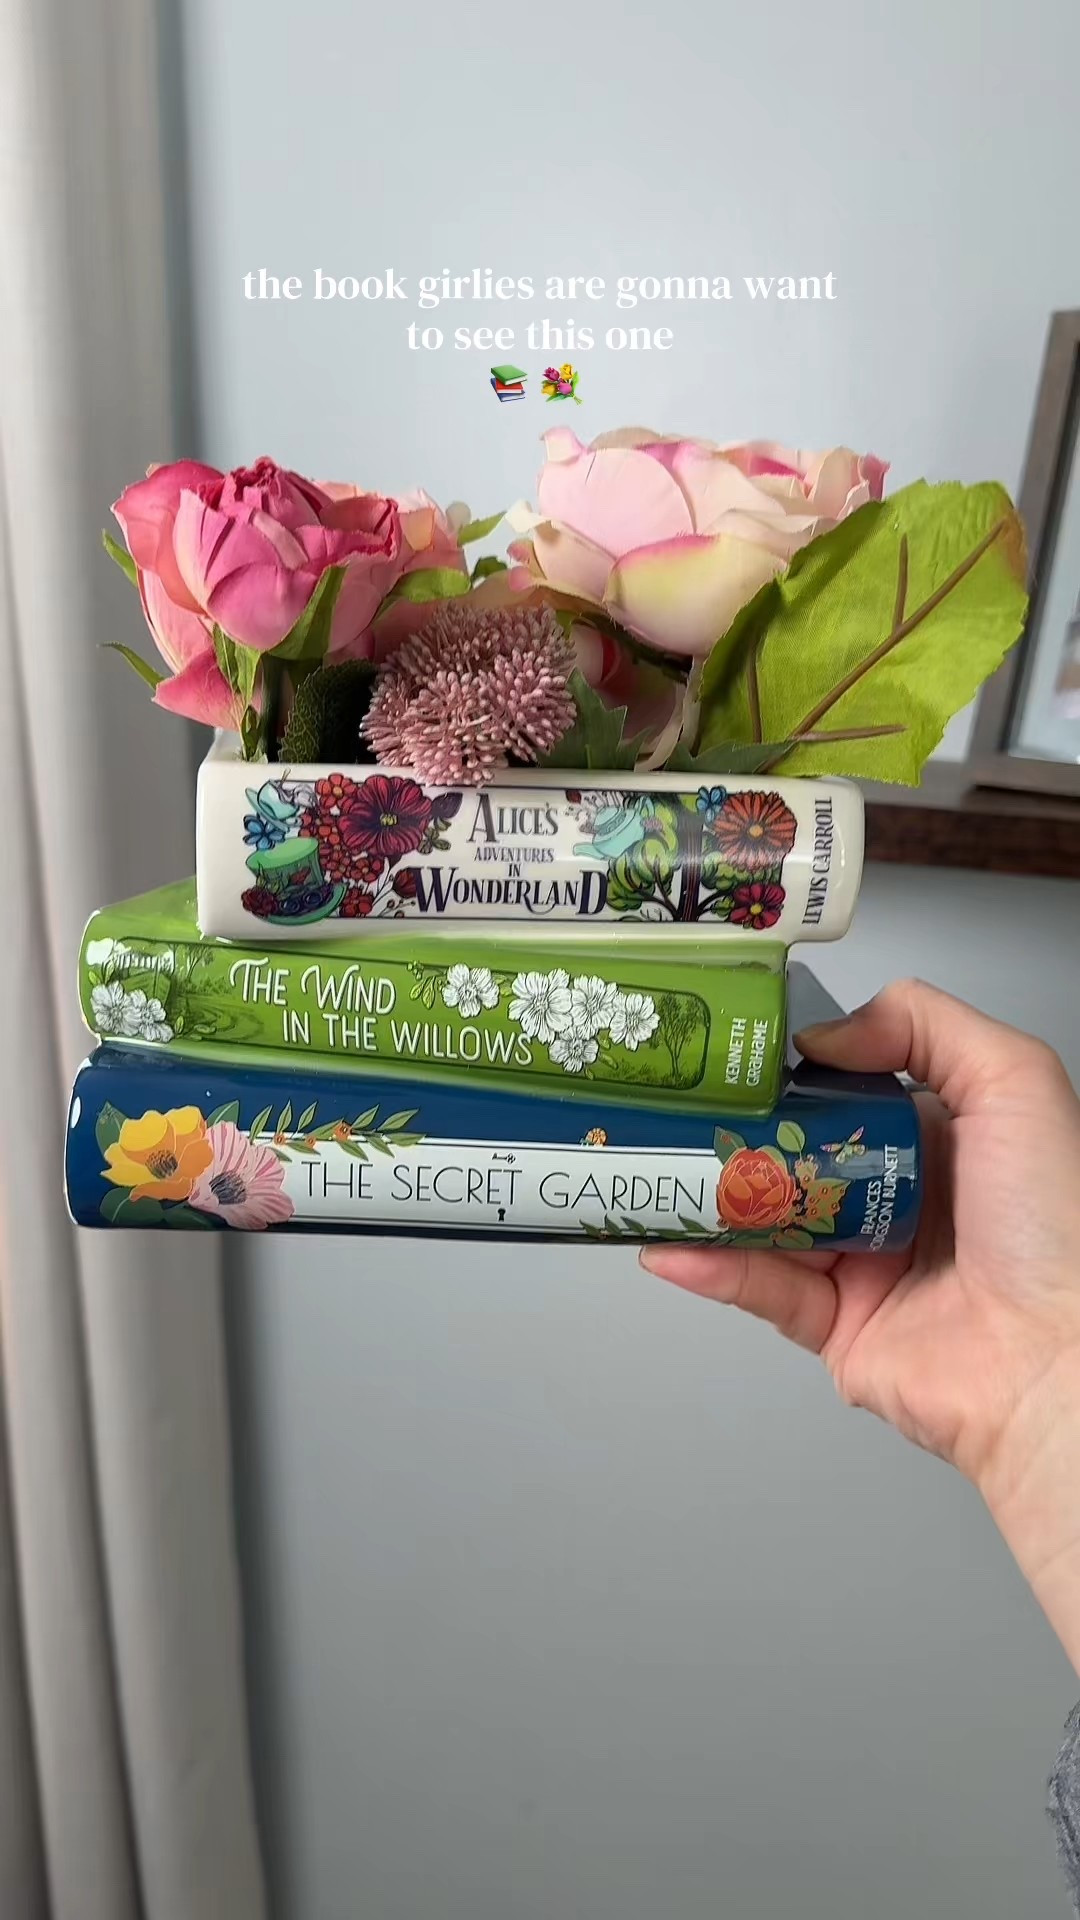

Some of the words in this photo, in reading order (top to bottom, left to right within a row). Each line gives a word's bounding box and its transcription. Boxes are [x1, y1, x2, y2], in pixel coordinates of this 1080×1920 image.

[466, 792, 559, 844] ALICE'S
[812, 796, 834, 874] CARROLL
[474, 846, 555, 864] ADVENTURES
[508, 863, 521, 878] IN
[408, 866, 608, 916] WONDERLAND
[802, 877, 828, 925] LEWIS
[229, 956, 291, 1007] THE
[300, 964, 397, 1016] WIND
[282, 1010, 312, 1046] IN
[322, 1013, 378, 1051] THE
[390, 1019, 534, 1066] WILLOWS
[724, 1017, 747, 1085] KENNETH
[301, 1161, 374, 1200] THE
[390, 1164, 523, 1206] SECRET
[538, 1171, 705, 1214] GARDEN
[860, 1180, 881, 1235] FRANCES
[869, 1201, 894, 1252] ODGSON
[882, 1144, 898, 1200] BURNETT
